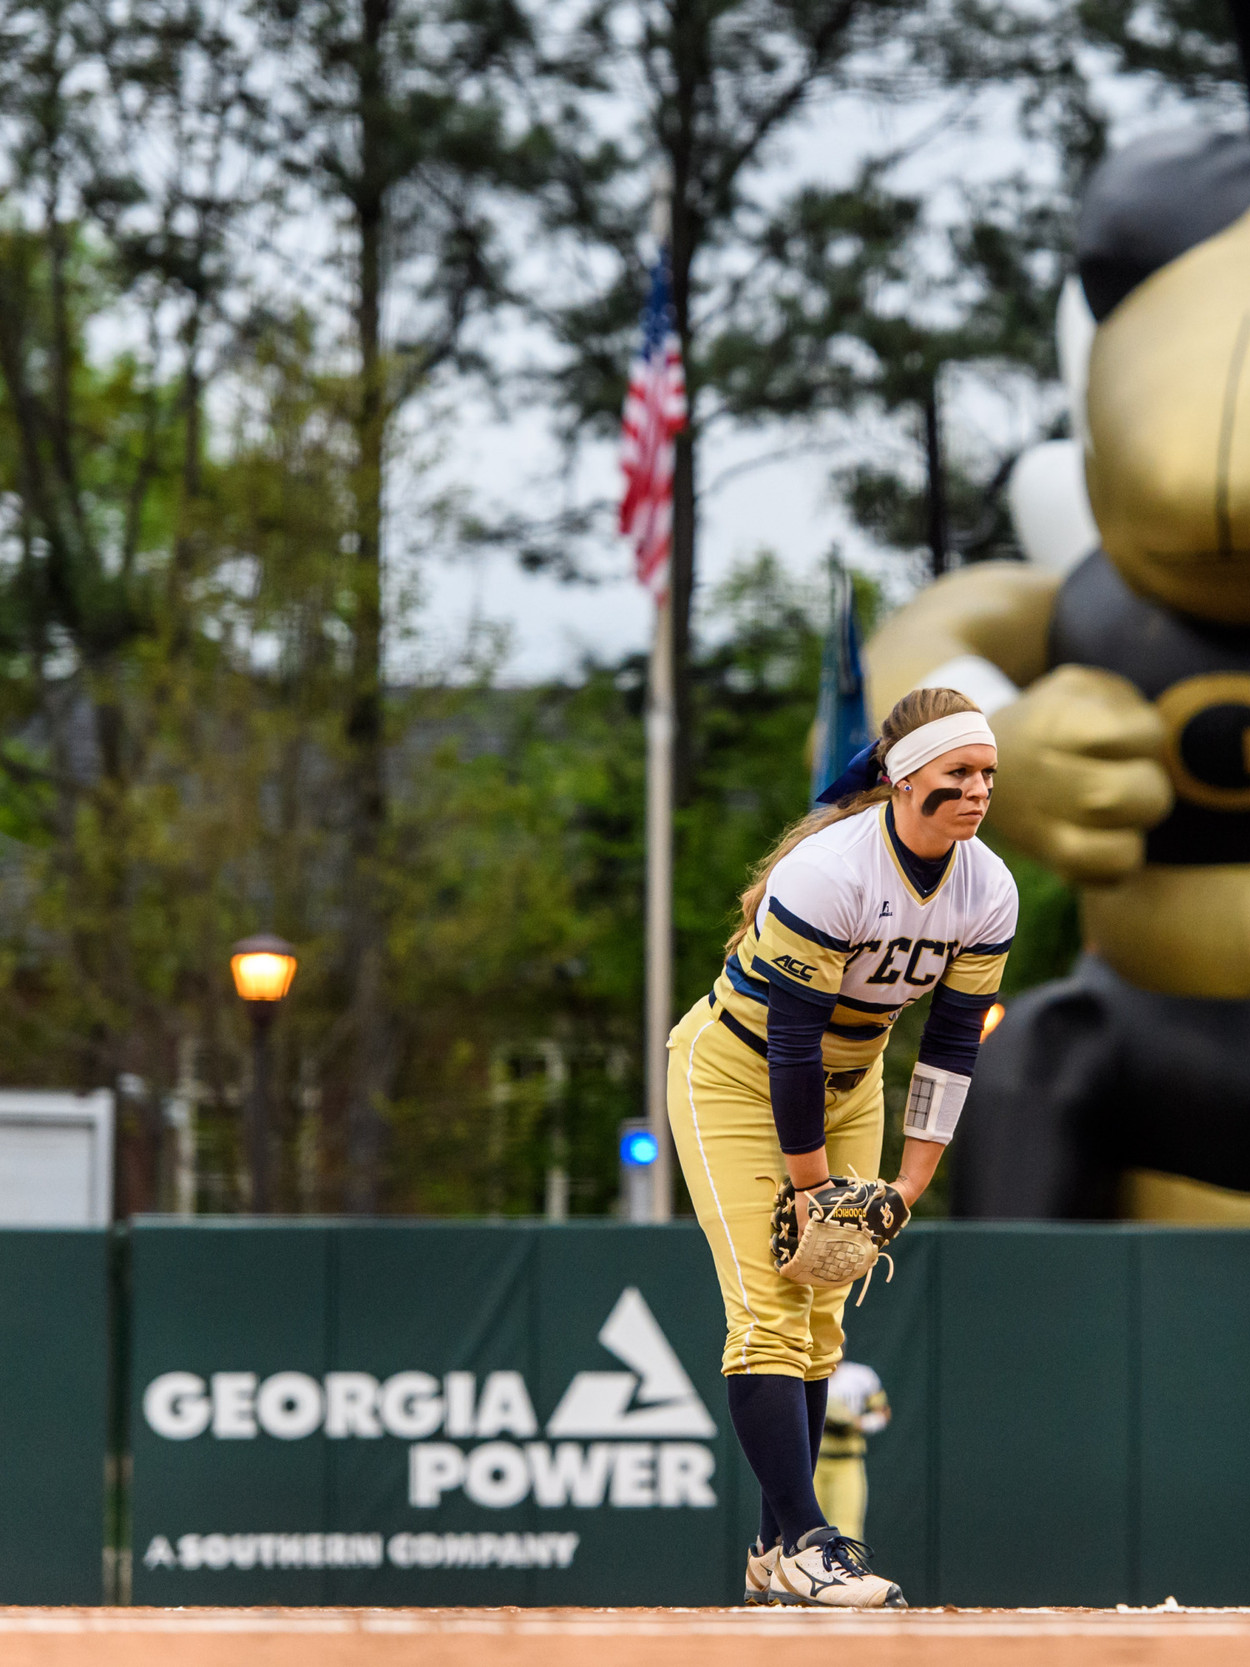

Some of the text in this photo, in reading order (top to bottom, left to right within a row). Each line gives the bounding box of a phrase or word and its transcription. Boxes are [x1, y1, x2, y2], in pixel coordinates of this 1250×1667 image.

[770, 955, 819, 982] ACC
[143, 1370, 538, 1441] GEORGIA
[409, 1442, 717, 1508] POWER
[145, 1532, 579, 1569] A SOUTHERN COMPANY
